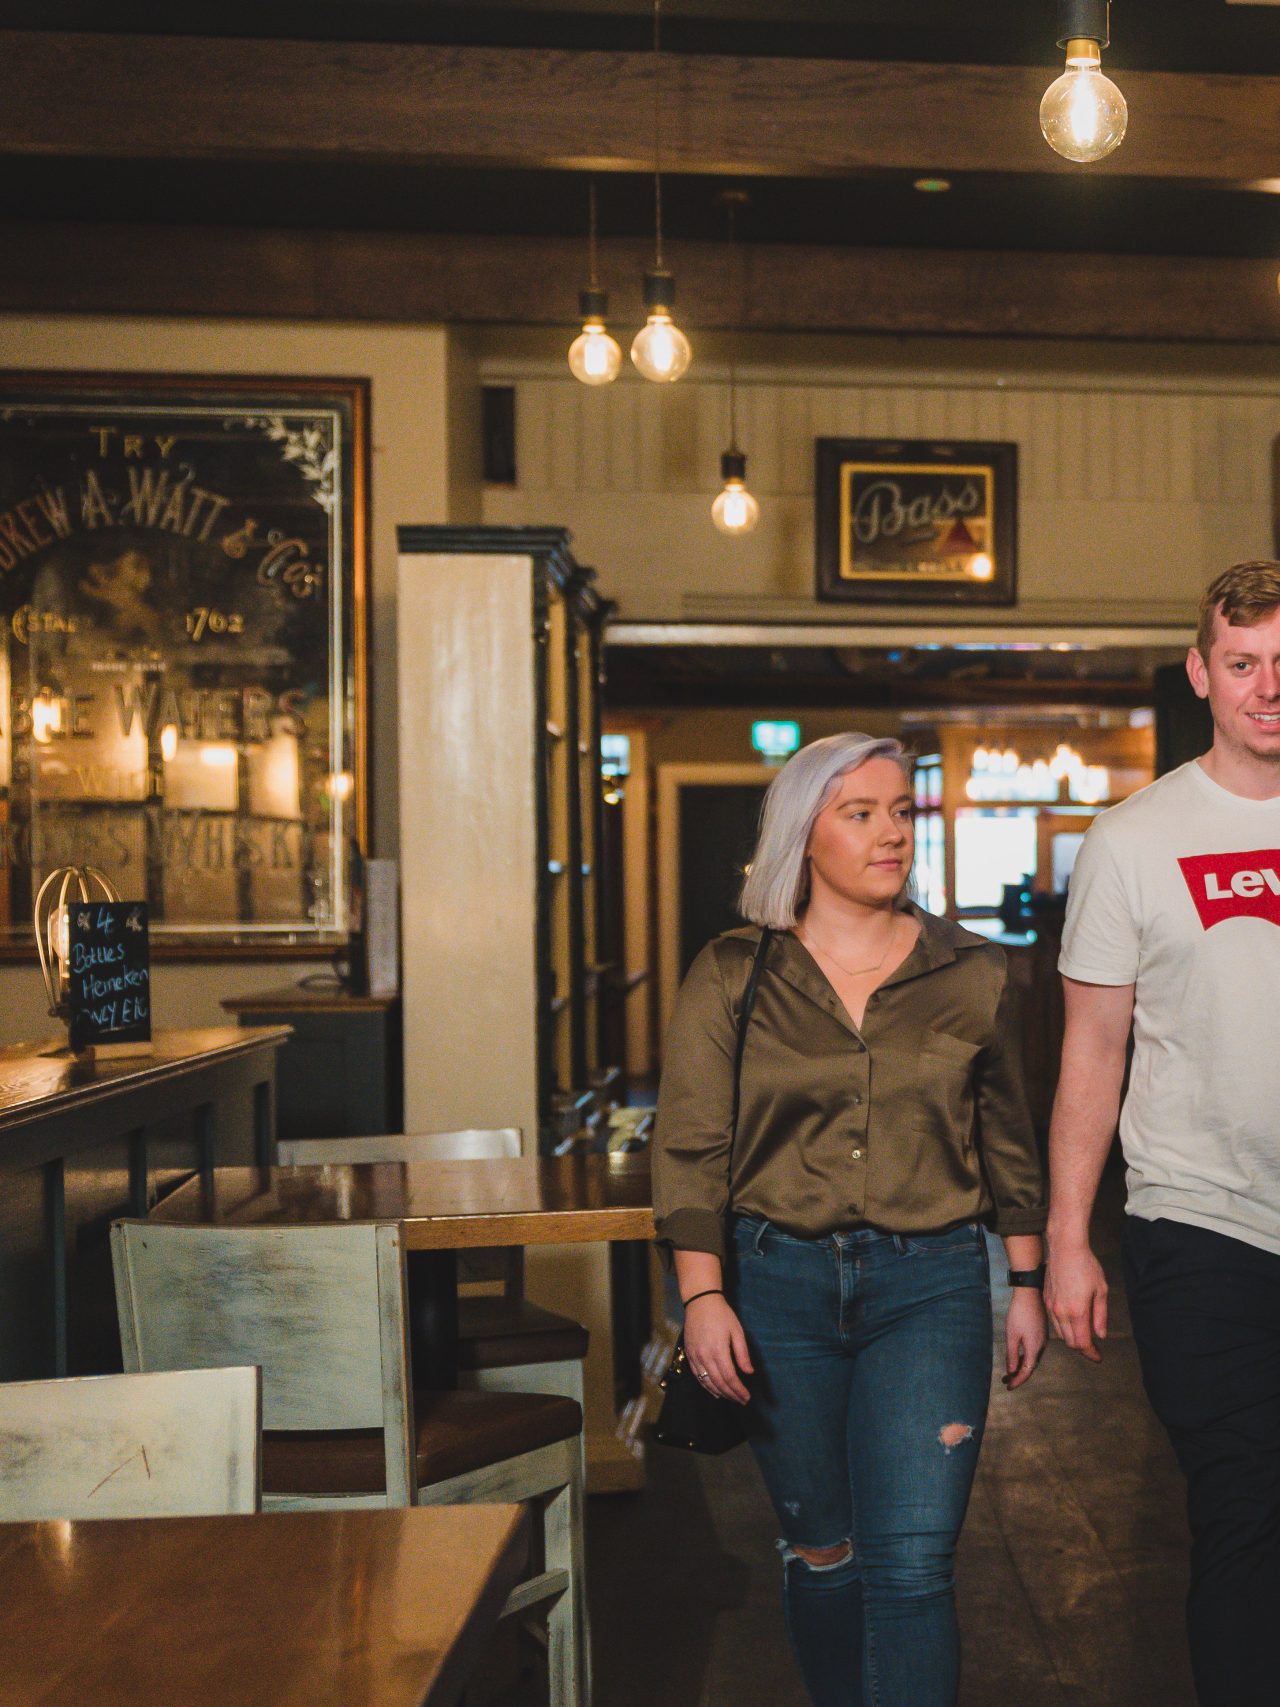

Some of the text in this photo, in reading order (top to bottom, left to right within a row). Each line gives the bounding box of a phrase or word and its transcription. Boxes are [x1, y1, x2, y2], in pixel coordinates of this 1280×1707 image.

[90, 425, 176, 459] TRY
[127, 465, 229, 542] WATT
[853, 480, 979, 545] Bass
[97, 906, 115, 935] 4
[82, 964, 148, 1000] Heineken
